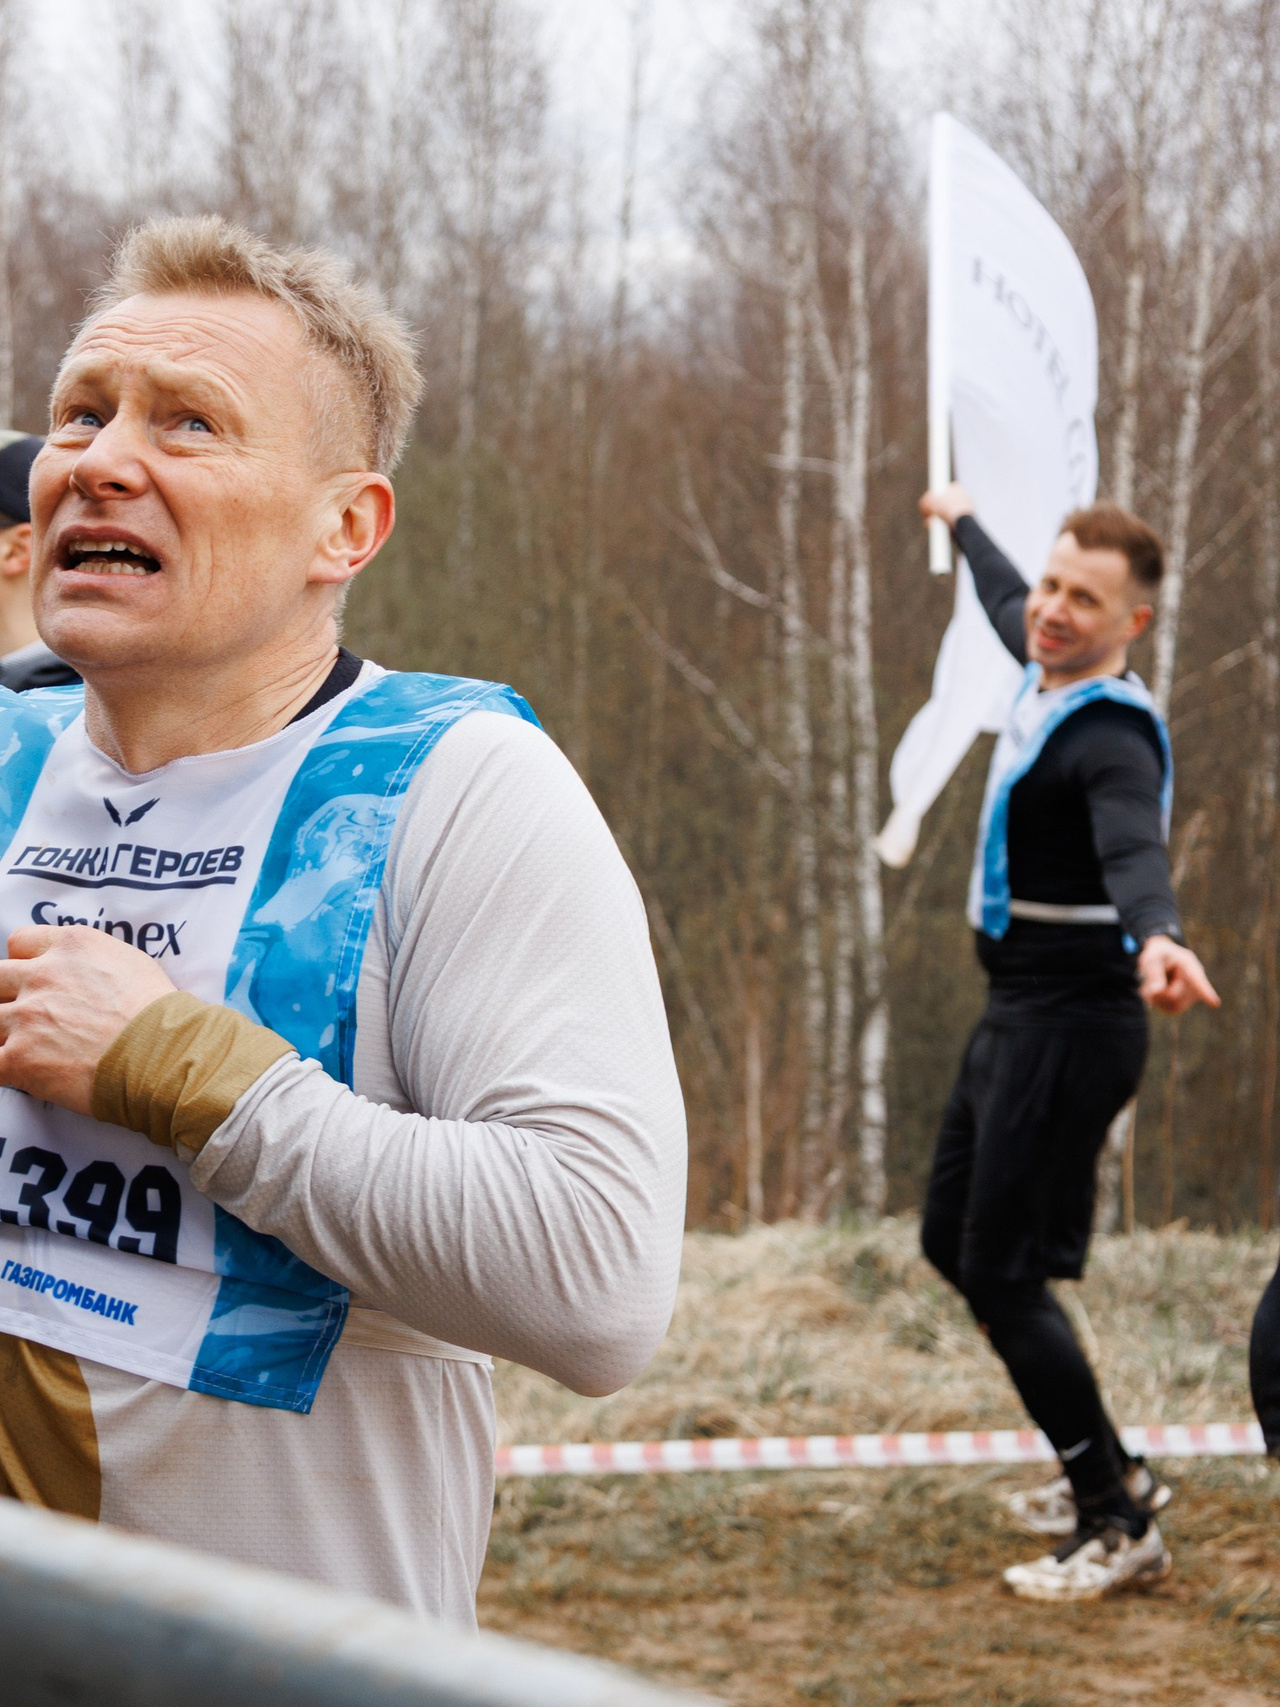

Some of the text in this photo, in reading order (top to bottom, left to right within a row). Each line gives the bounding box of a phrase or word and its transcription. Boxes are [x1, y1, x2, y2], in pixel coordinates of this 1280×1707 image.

[13, 842, 245, 879] ГОНКА ГЕРОЕВ
[1, 1259, 139, 1326] ГАЗПРОМБАНК
